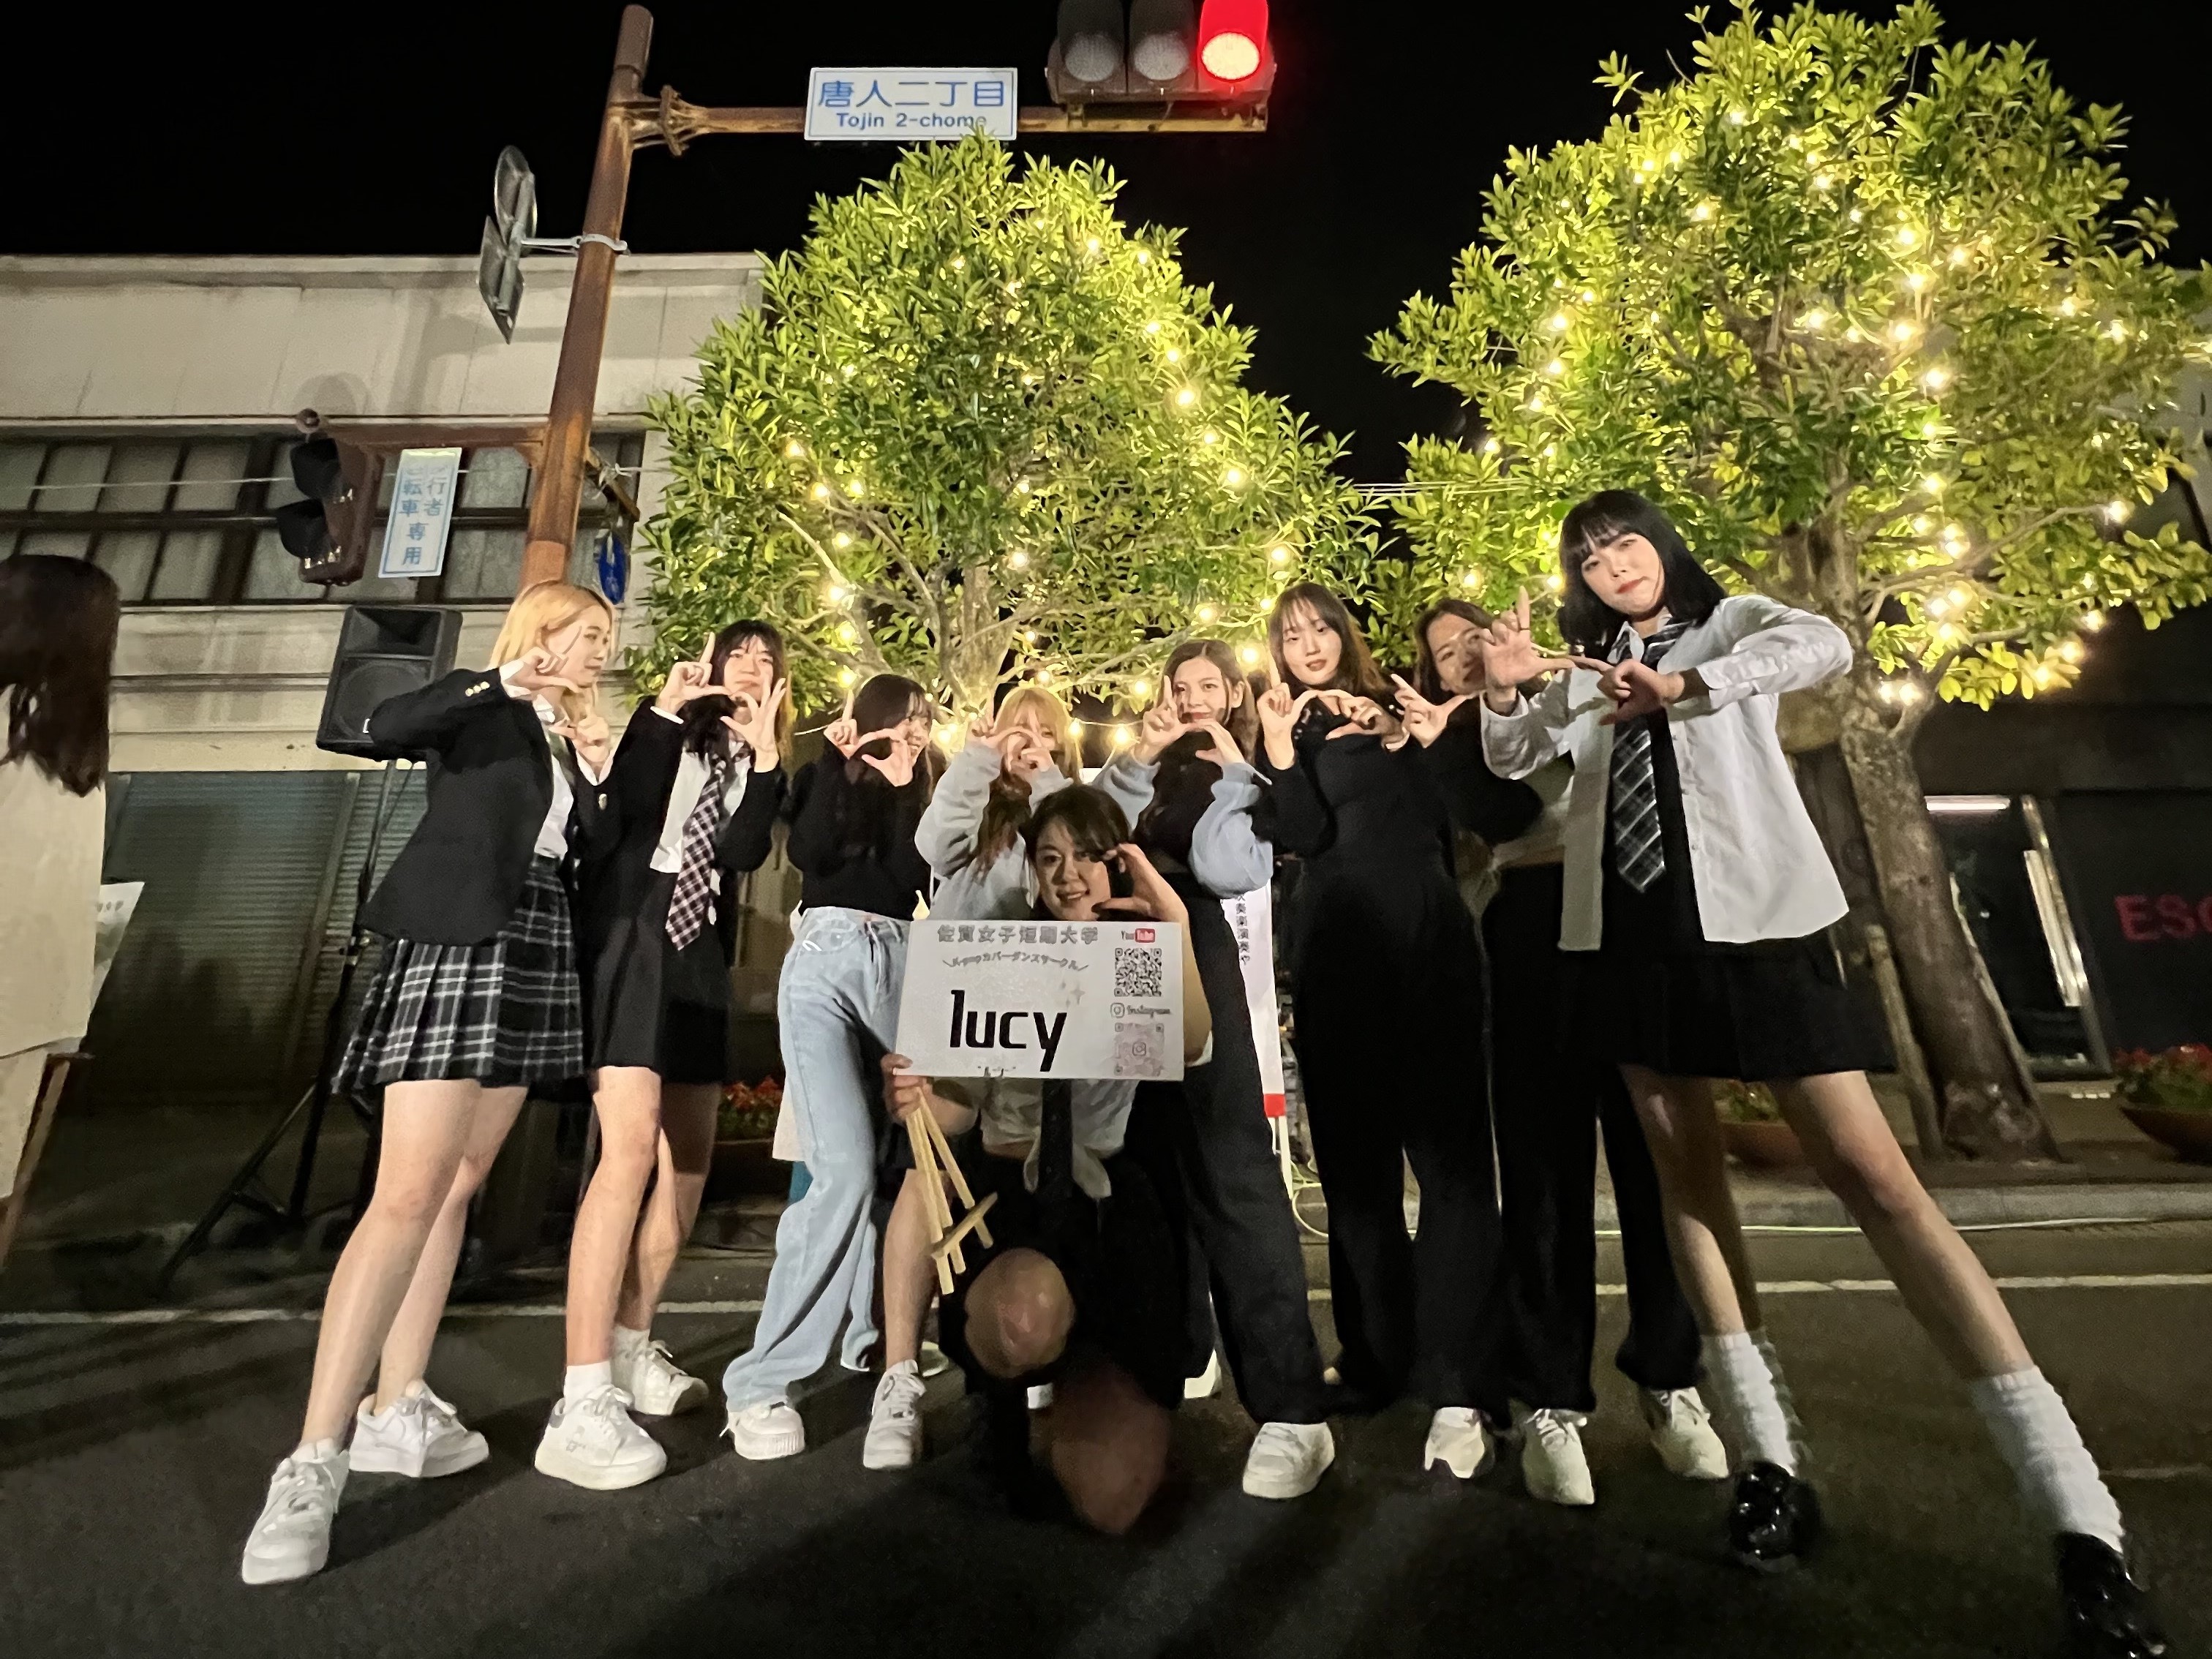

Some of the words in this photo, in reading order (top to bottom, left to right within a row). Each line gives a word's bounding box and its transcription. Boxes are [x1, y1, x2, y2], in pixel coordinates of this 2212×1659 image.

[818, 79, 1004, 108] 唐人二丁目
[836, 112, 885, 130] Tojin
[895, 112, 988, 128] 2-chome
[949, 989, 1067, 1072] lucy
